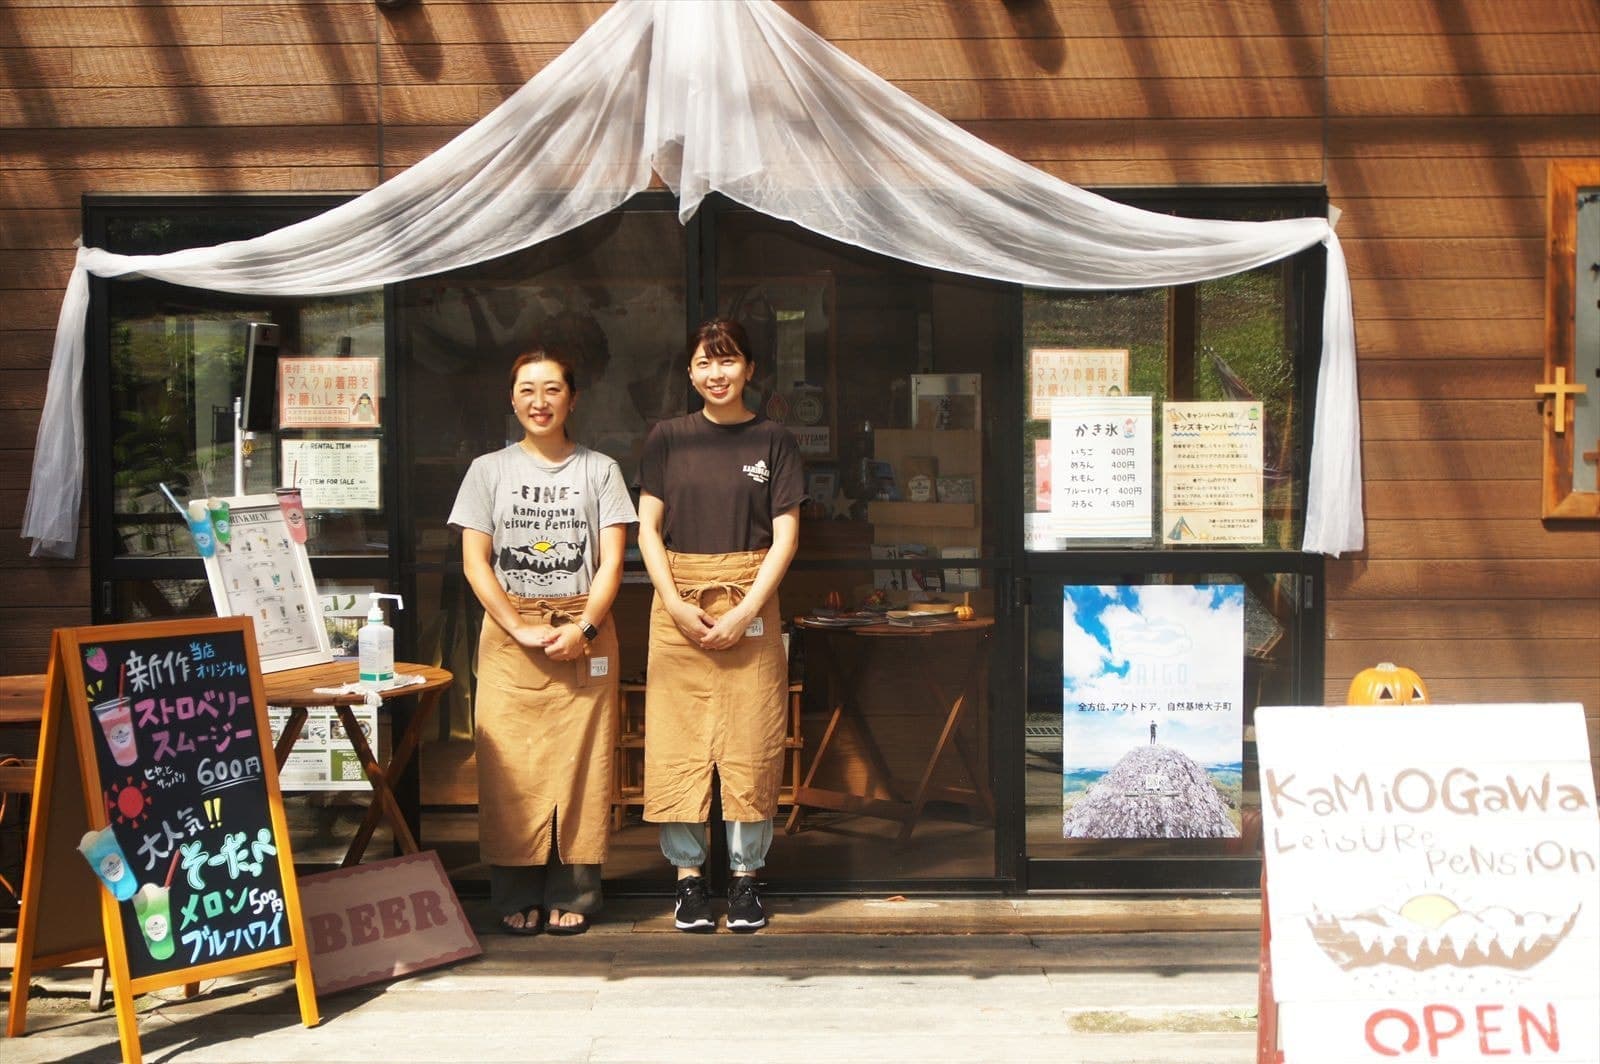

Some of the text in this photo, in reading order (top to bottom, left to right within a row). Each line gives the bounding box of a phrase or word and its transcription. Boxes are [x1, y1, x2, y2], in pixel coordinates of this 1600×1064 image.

[1075, 423, 1119, 437] かき氷
[310, 442, 335, 450] RENTAL
[336, 442, 352, 450] ITEM
[1071, 447, 1135, 456] いちご 400円
[1070, 460, 1136, 469] めろん 400円
[1070, 473, 1136, 482] れもん 400円
[1118, 486, 1142, 495] 400円
[1071, 500, 1135, 508] みるく 450円
[545, 518, 587, 530] Pension
[189, 641, 216, 661] 当店
[126, 649, 192, 693] 新作
[195, 661, 247, 679] オリジナル
[134, 690, 251, 729] ストロベリー
[151, 722, 253, 762] スムージー
[197, 755, 261, 786] 600円
[179, 887, 248, 931] メロン
[249, 887, 284, 915] 500円
[308, 890, 449, 954] BEER
[180, 911, 284, 964] ブルーハワイ
[1364, 1002, 1561, 1057] OPEN
